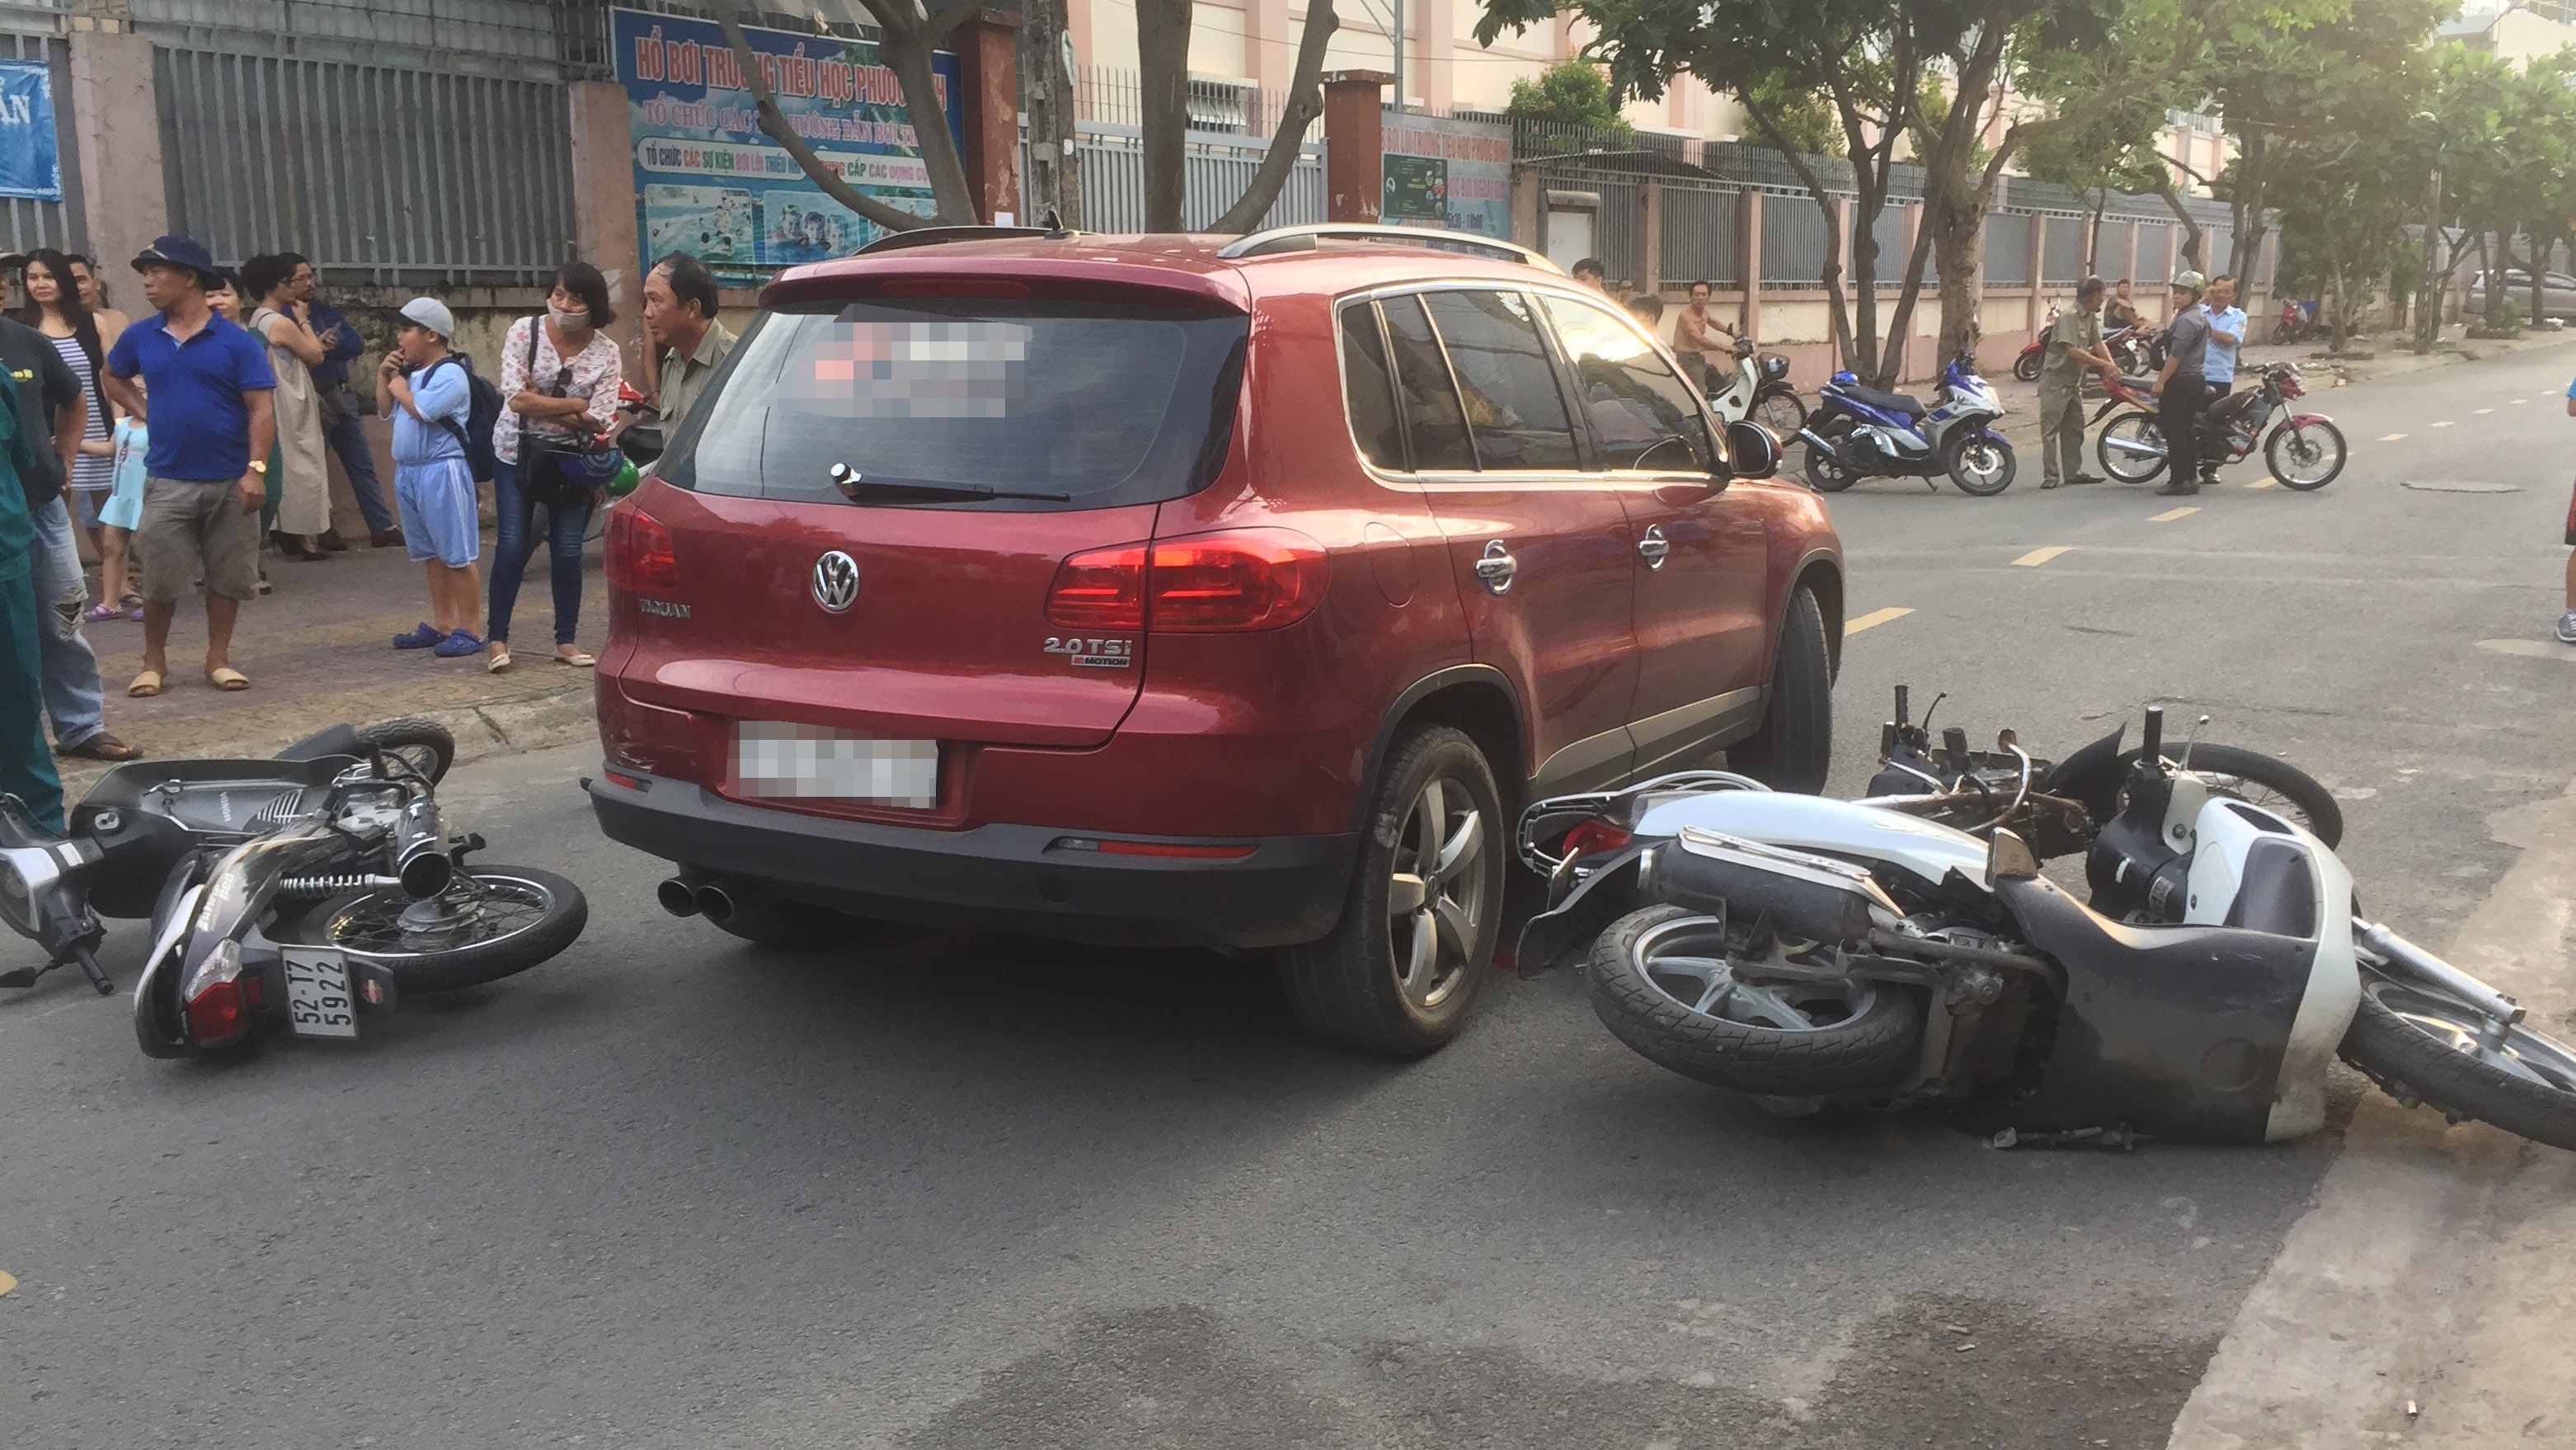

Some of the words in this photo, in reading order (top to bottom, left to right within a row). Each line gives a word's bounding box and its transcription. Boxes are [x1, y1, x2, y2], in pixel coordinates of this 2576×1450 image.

[635, 25, 665, 81] HỒ
[666, 39, 702, 85] BƠI
[777, 42, 816, 97] TIỂU
[817, 59, 853, 108] HỌC
[847, 157, 867, 177] CẤP
[639, 598, 691, 619] TIGUAN
[219, 791, 232, 822] HONDA
[286, 960, 321, 1024] 52-T7
[316, 962, 351, 1025] 5922
